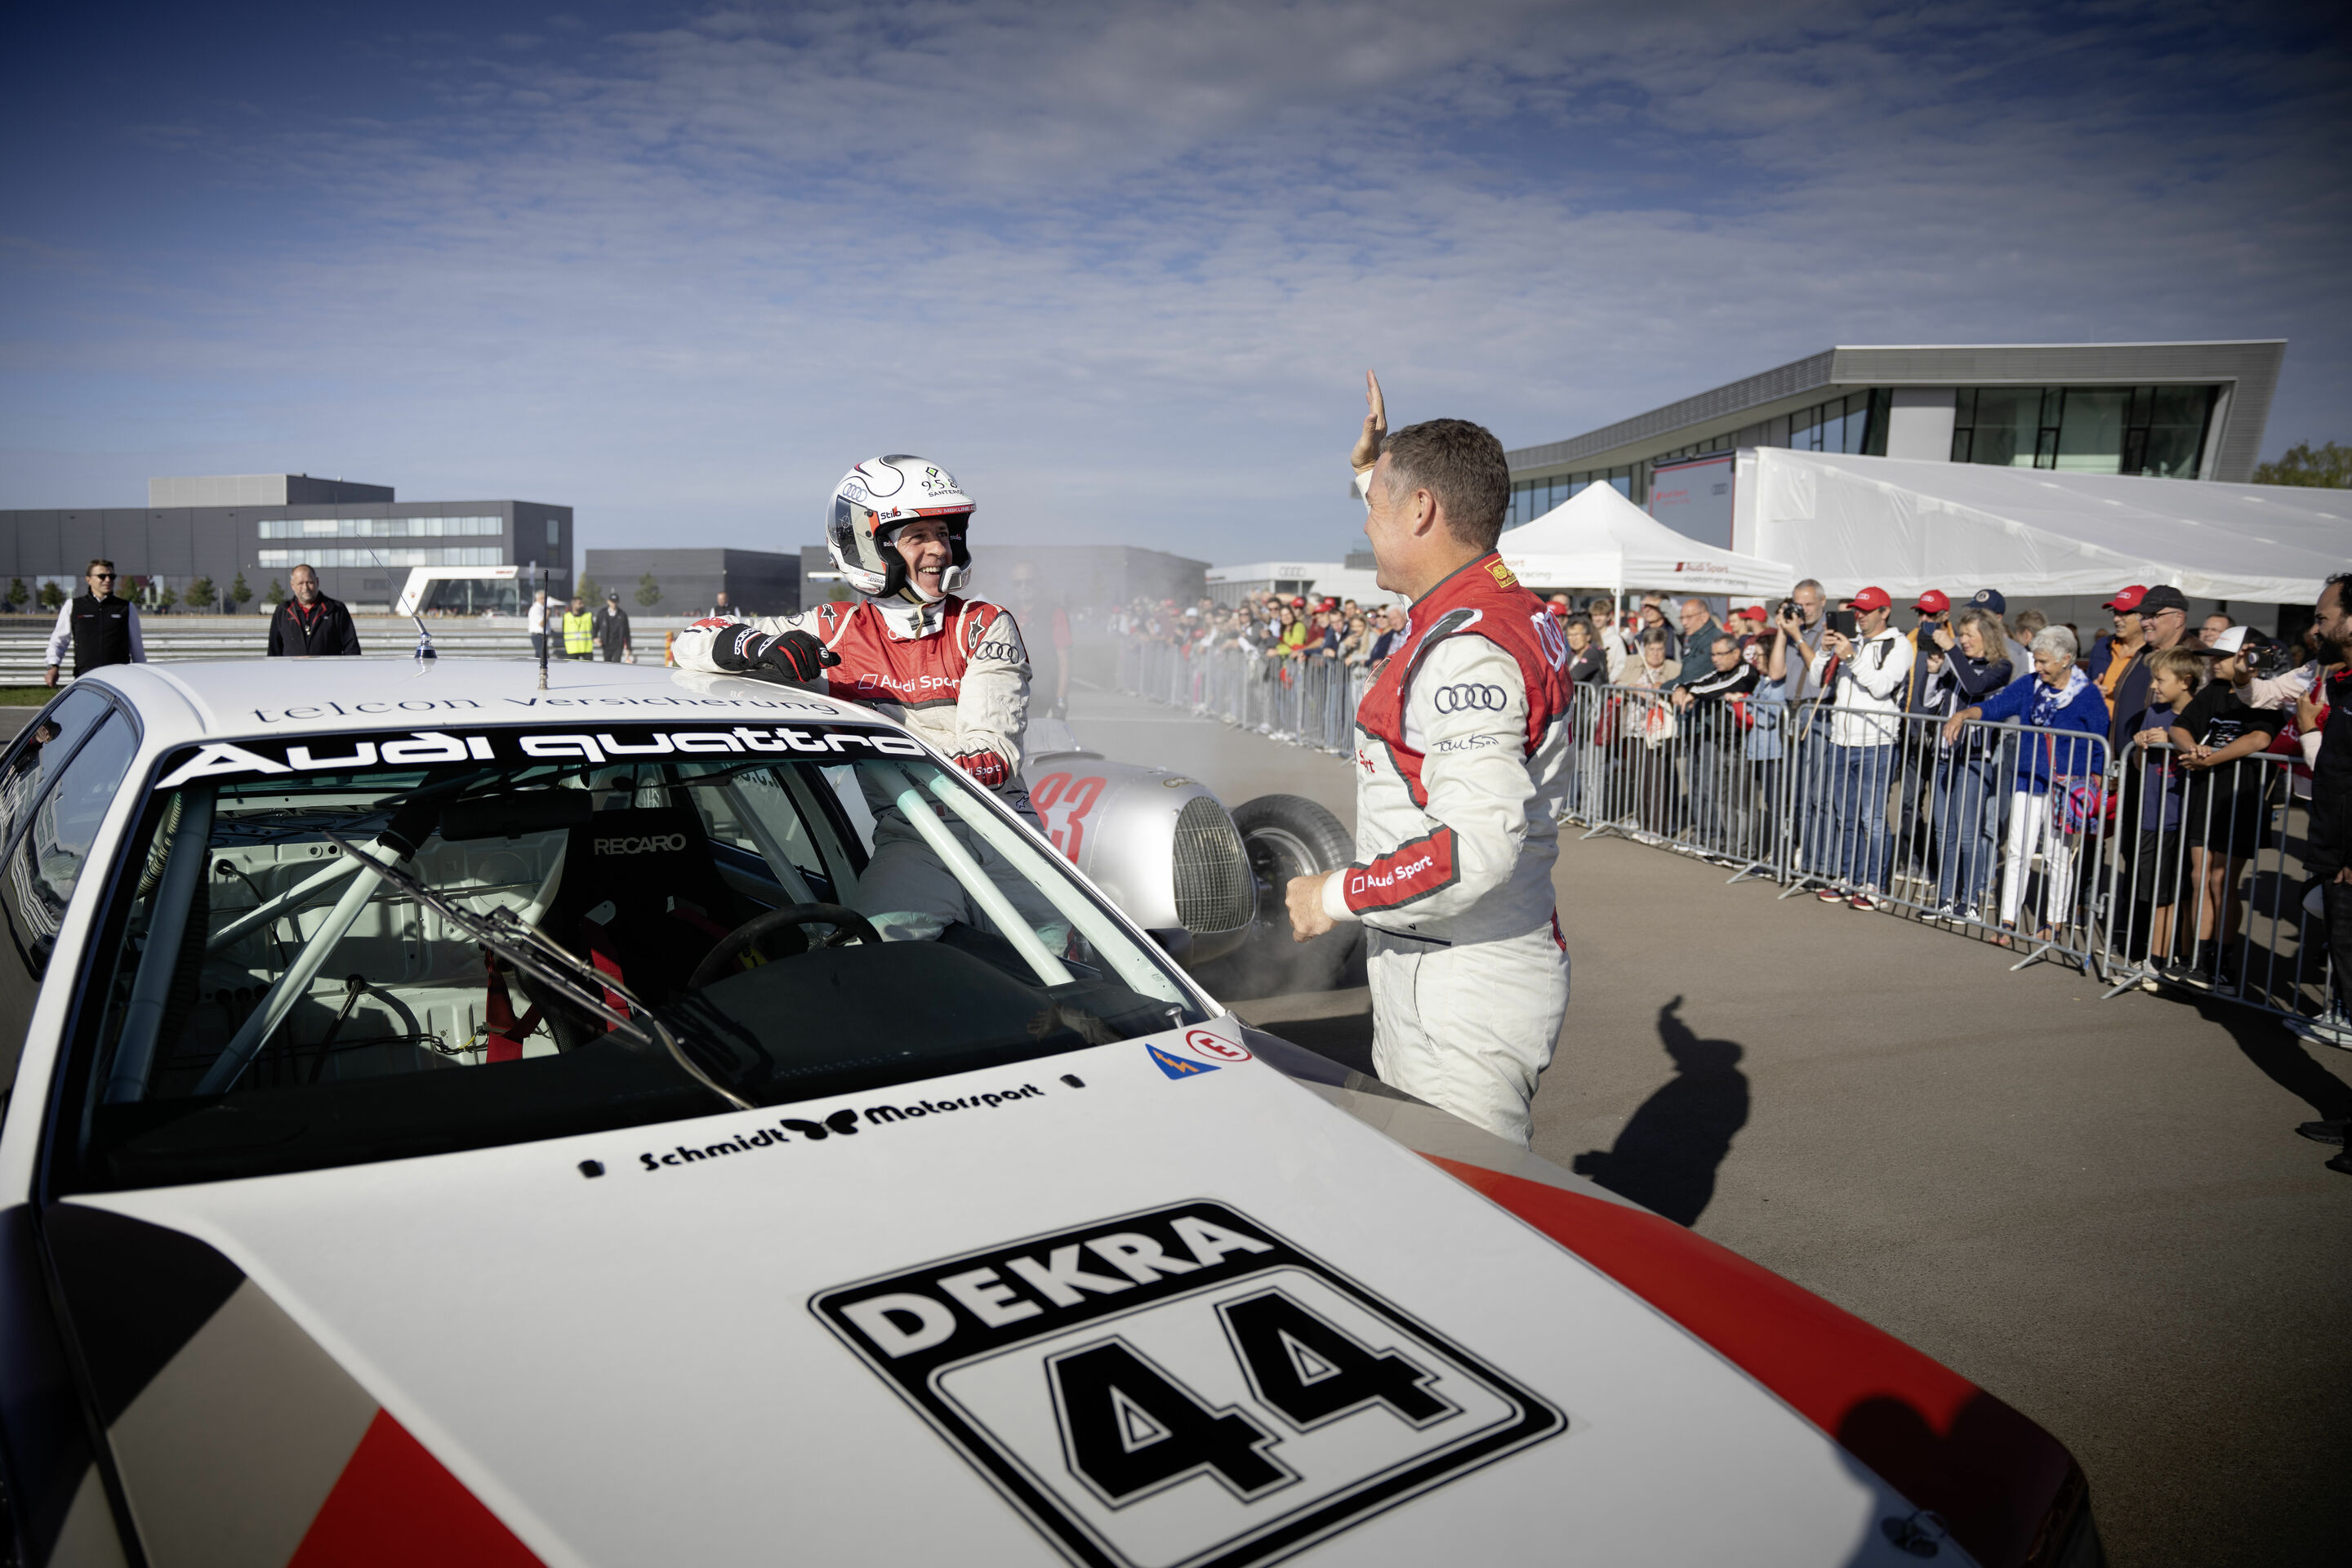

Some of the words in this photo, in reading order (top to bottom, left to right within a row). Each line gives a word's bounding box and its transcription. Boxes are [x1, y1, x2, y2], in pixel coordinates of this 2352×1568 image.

[880, 506, 902, 520] Stilo
[880, 674, 915, 693] Audi
[919, 675, 961, 690] Spor
[250, 698, 485, 723] telcon
[502, 696, 840, 715] Versicherung
[154, 731, 496, 791] Audi
[519, 727, 927, 763] quattro
[593, 832, 687, 856] RECARO
[1366, 871, 1395, 888] Audi
[1394, 855, 1433, 880] Sport
[1196, 1037, 1241, 1058] E
[639, 1129, 791, 1171] Schmidt
[863, 1084, 1046, 1125] Motorsport
[840, 1215, 1276, 1359] DEKRA
[1043, 1285, 1468, 1512] 44
